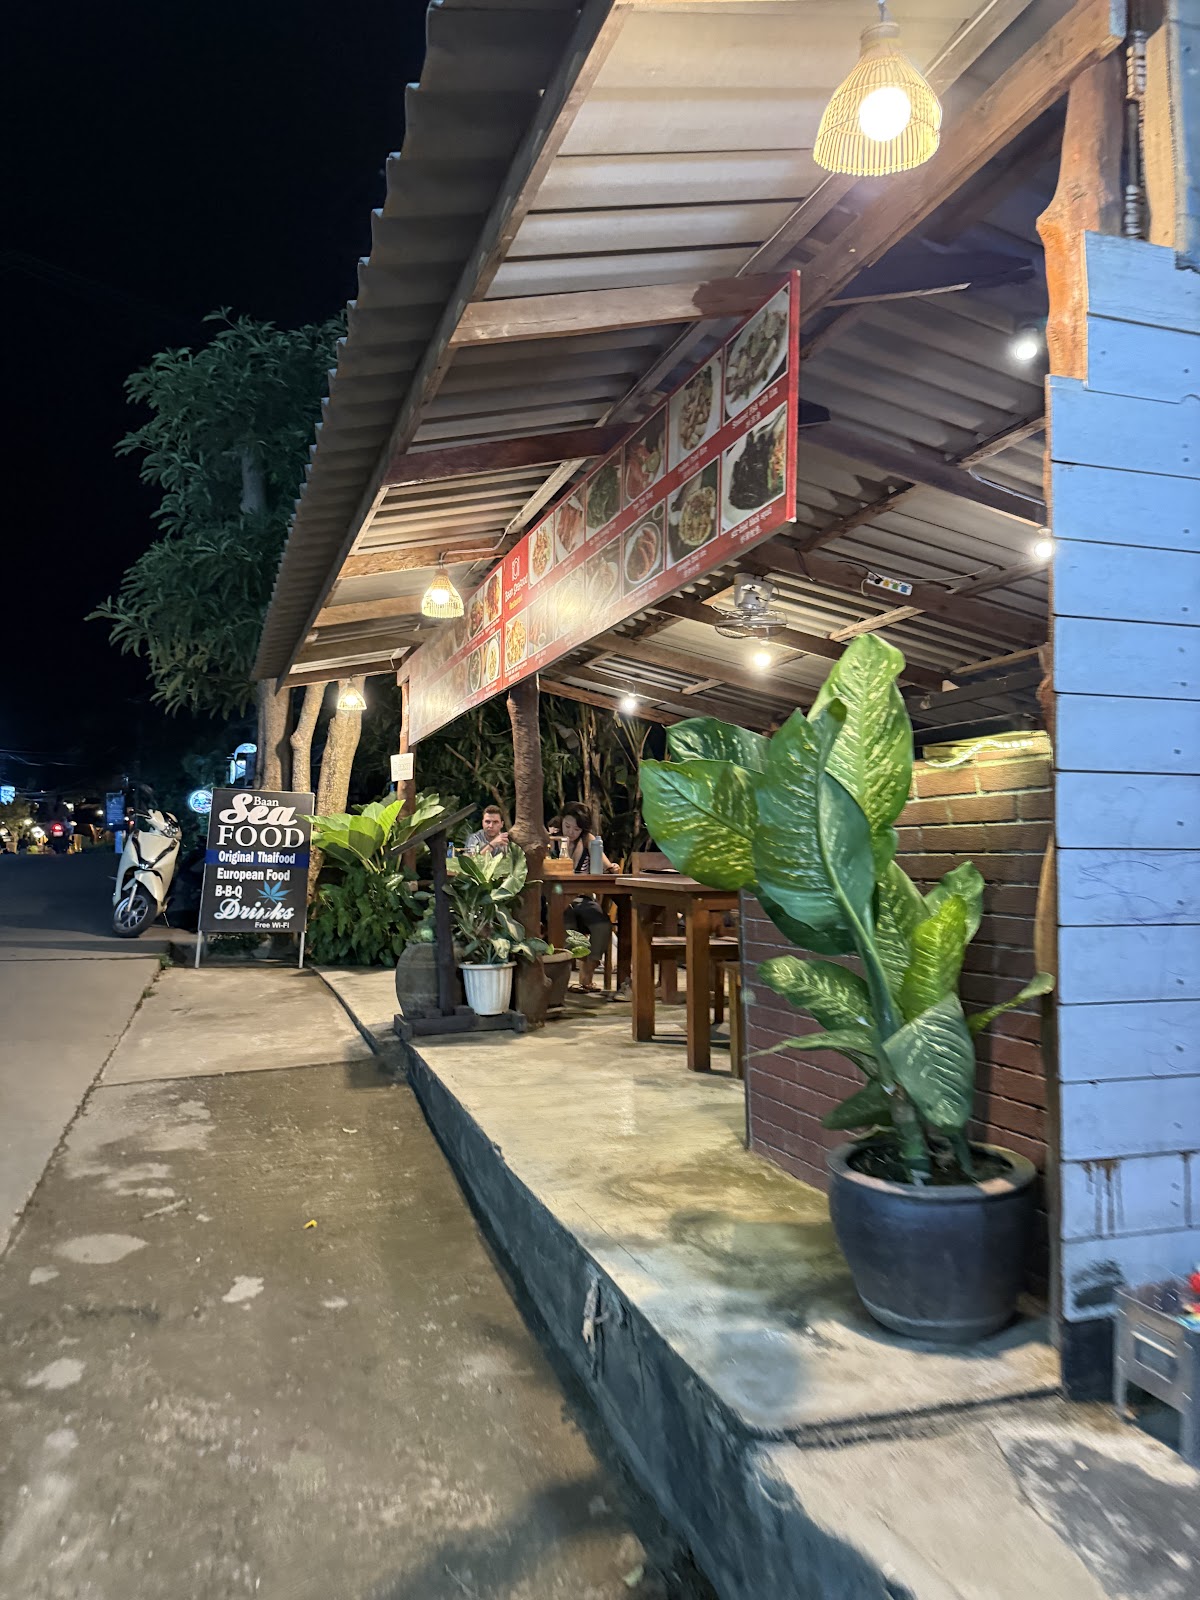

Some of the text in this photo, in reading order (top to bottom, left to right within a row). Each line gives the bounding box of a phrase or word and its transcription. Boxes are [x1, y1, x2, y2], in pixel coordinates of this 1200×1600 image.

[253, 796, 279, 806] Baan
[219, 793, 297, 826] Sea
[216, 825, 305, 848] FOOD
[218, 850, 296, 865] Original Thaifood
[217, 867, 291, 882] European Food
[215, 885, 243, 898] B-B-Q
[213, 898, 295, 920] Drinks
